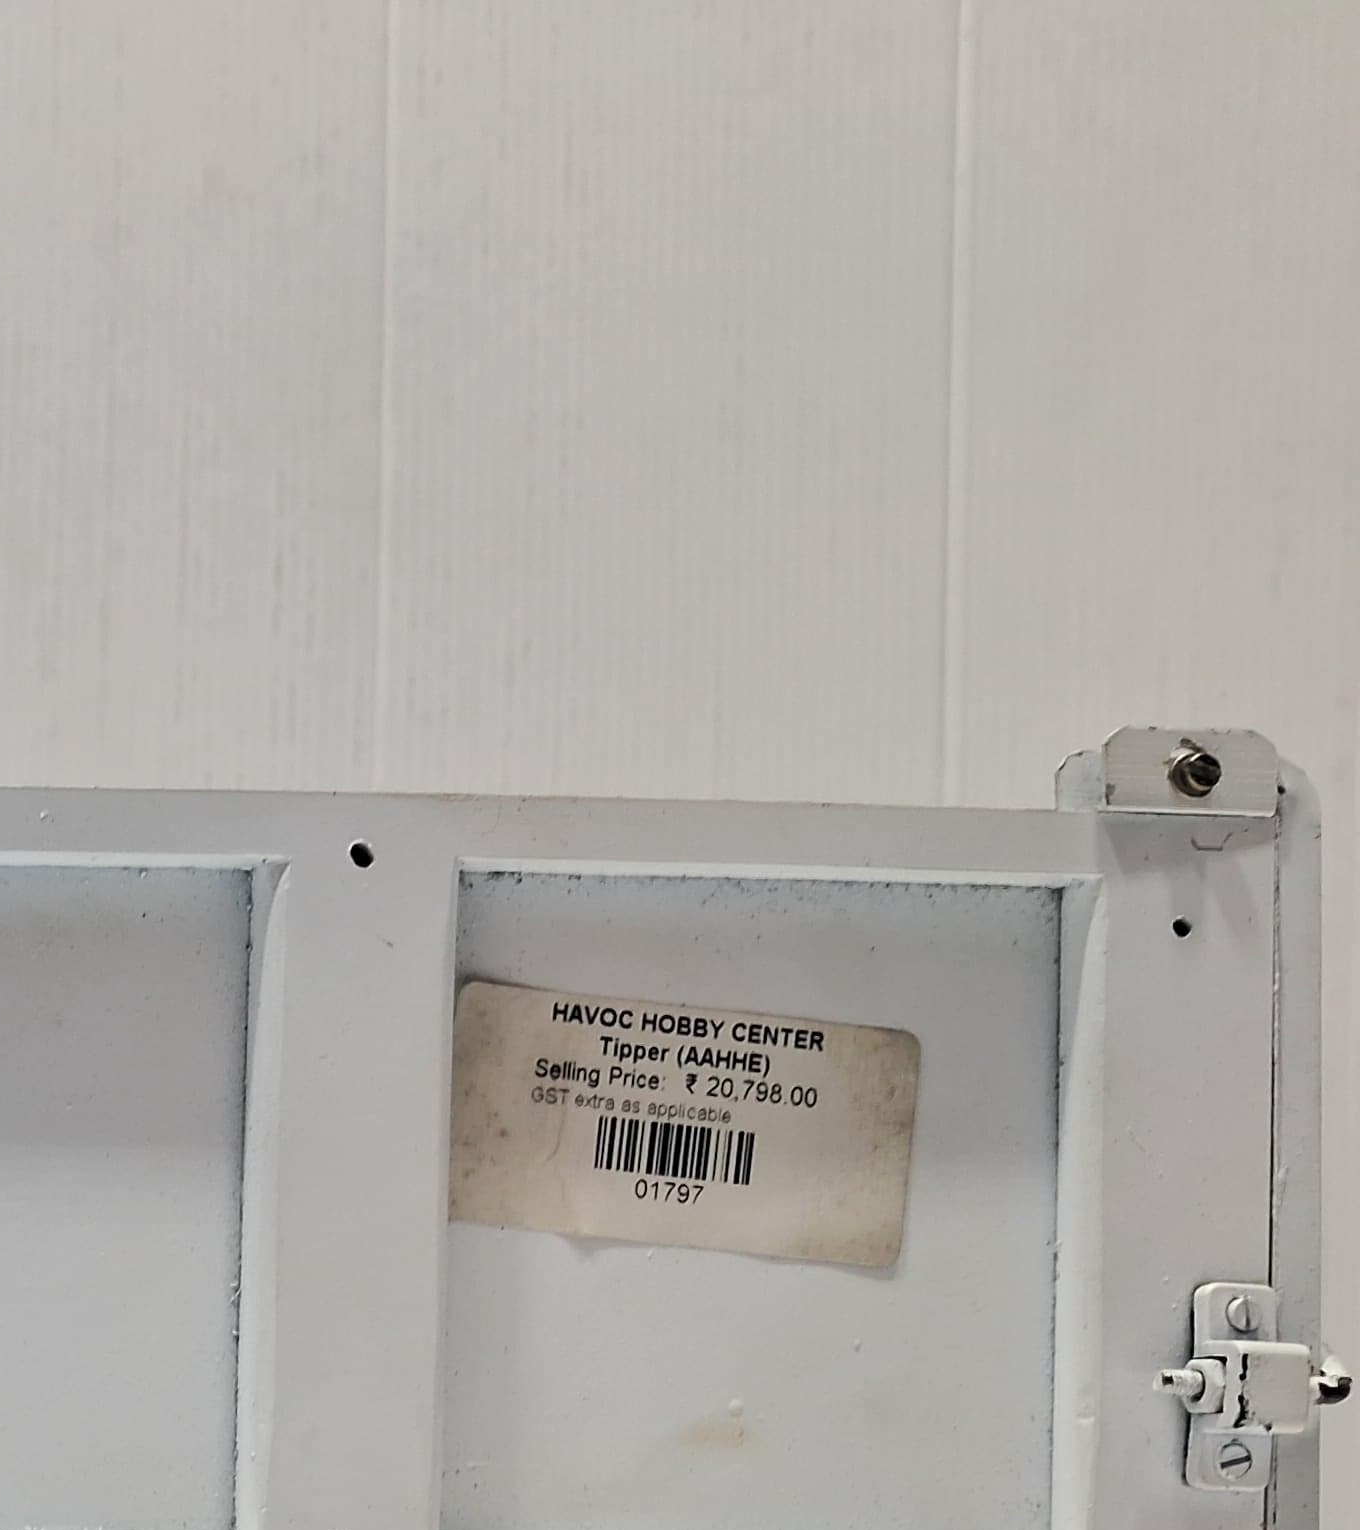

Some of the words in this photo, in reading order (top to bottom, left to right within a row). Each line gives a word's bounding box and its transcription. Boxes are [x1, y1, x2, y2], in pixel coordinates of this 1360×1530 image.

[552, 1002, 634, 1029] HAVOC
[641, 1013, 725, 1040] HOBBY
[731, 1022, 825, 1052] CENTER
[600, 1036, 670, 1064] Tipper
[677, 1045, 771, 1076] (AAHHE)
[535, 1059, 600, 1087] Selling
[609, 1067, 666, 1090] Price:
[707, 1076, 818, 1108] 20,798.00
[531, 1087, 570, 1105] GST
[575, 1094, 615, 1111] extra
[621, 1099, 641, 1114] as
[648, 1101, 732, 1124] applicable
[635, 1179, 704, 1204] 01797
